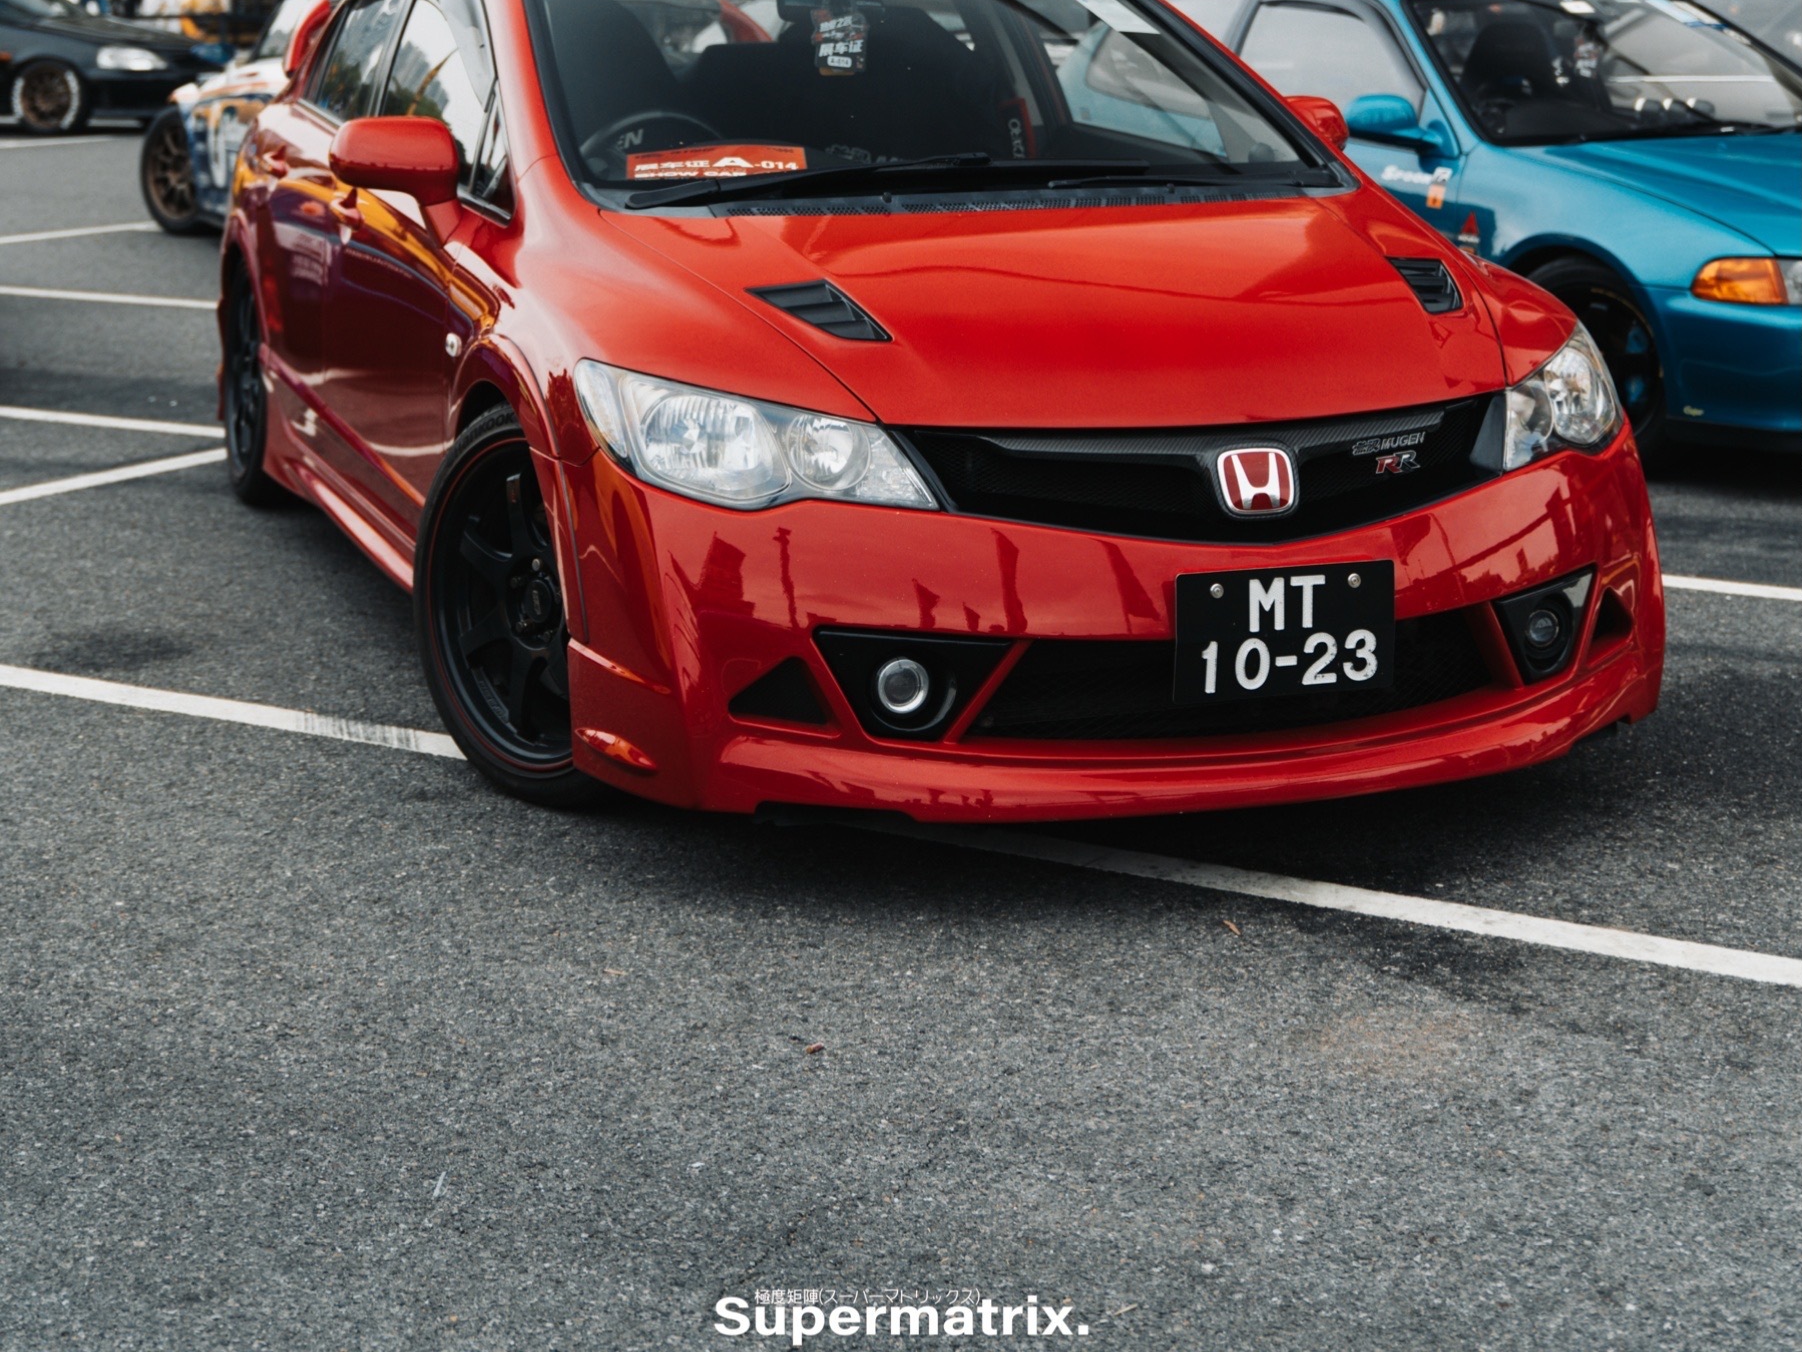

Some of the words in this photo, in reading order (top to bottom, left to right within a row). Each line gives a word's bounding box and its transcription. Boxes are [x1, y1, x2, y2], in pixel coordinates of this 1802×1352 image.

[1375, 449, 1421, 474] RR
[1380, 431, 1427, 451] MUGEN
[1248, 574, 1326, 633] MT
[1201, 628, 1378, 695] 10-23
